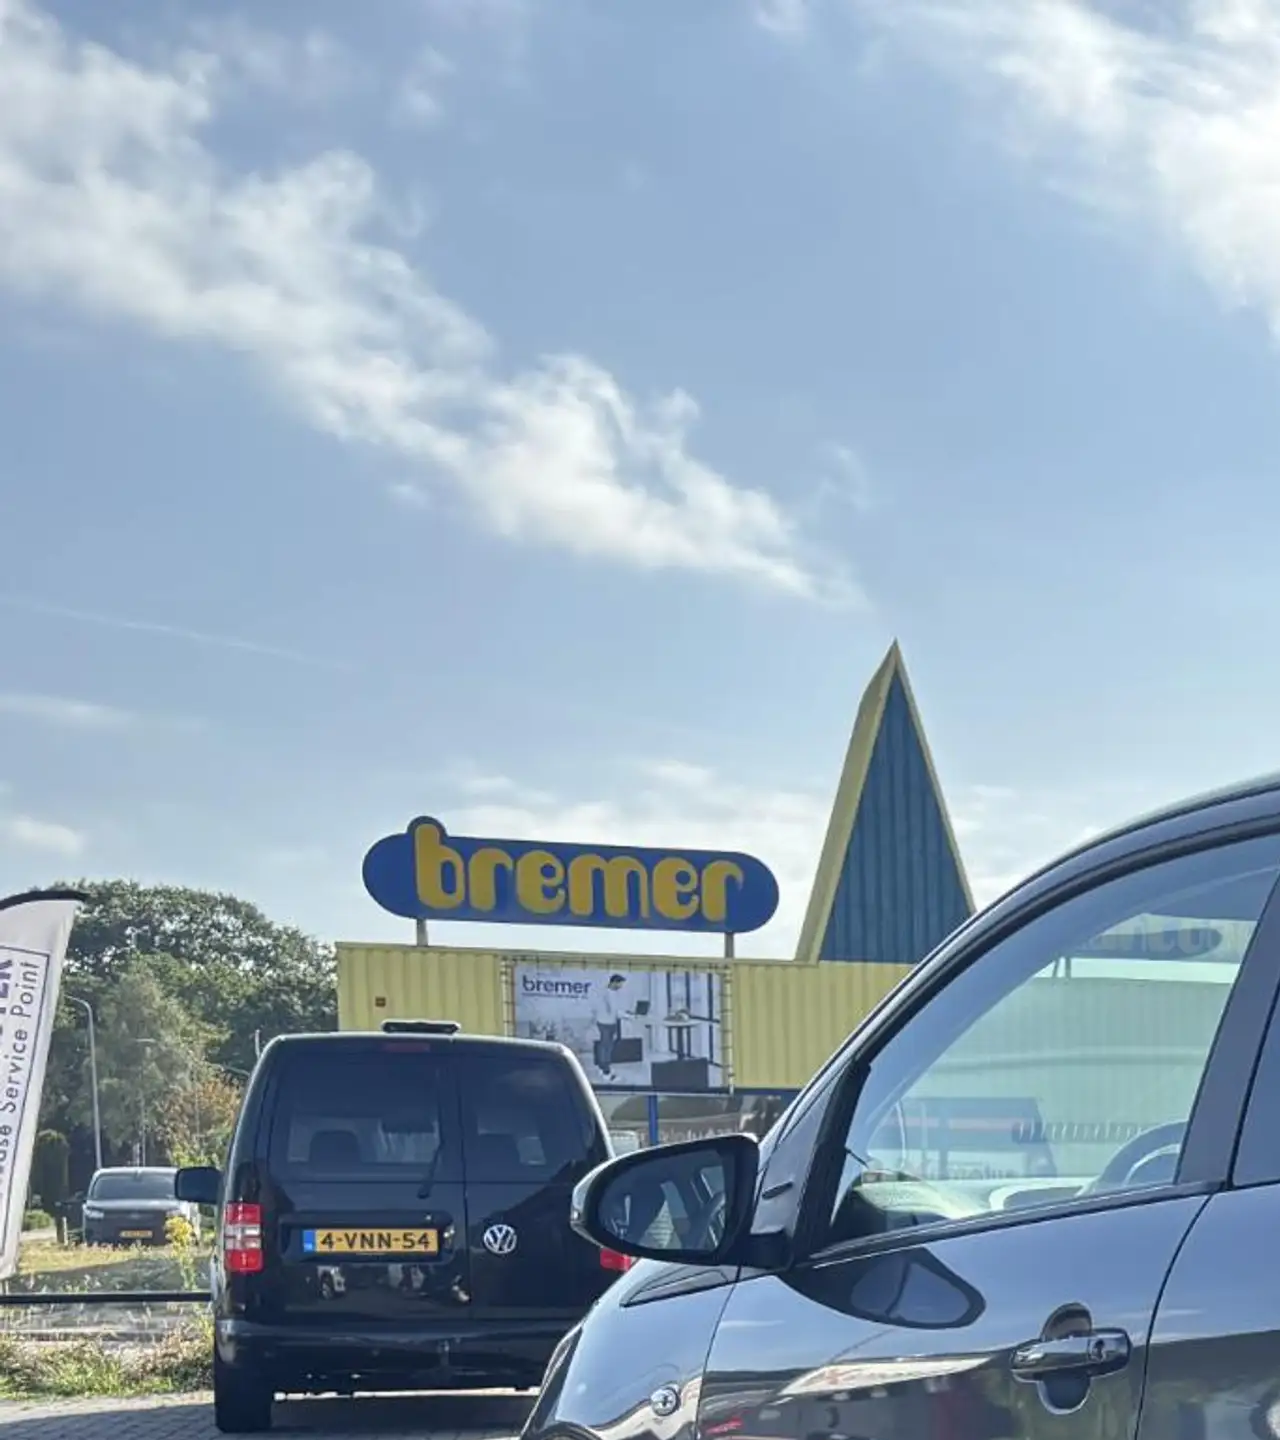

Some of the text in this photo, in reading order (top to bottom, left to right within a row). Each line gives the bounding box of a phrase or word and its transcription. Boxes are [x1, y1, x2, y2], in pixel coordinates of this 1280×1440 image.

[414, 823, 744, 922] bremer
[11, 961, 40, 1018] Point
[522, 974, 592, 994] bremer
[0, 1029, 28, 1114] Service
[320, 1232, 431, 1250] 4-VNN-54
